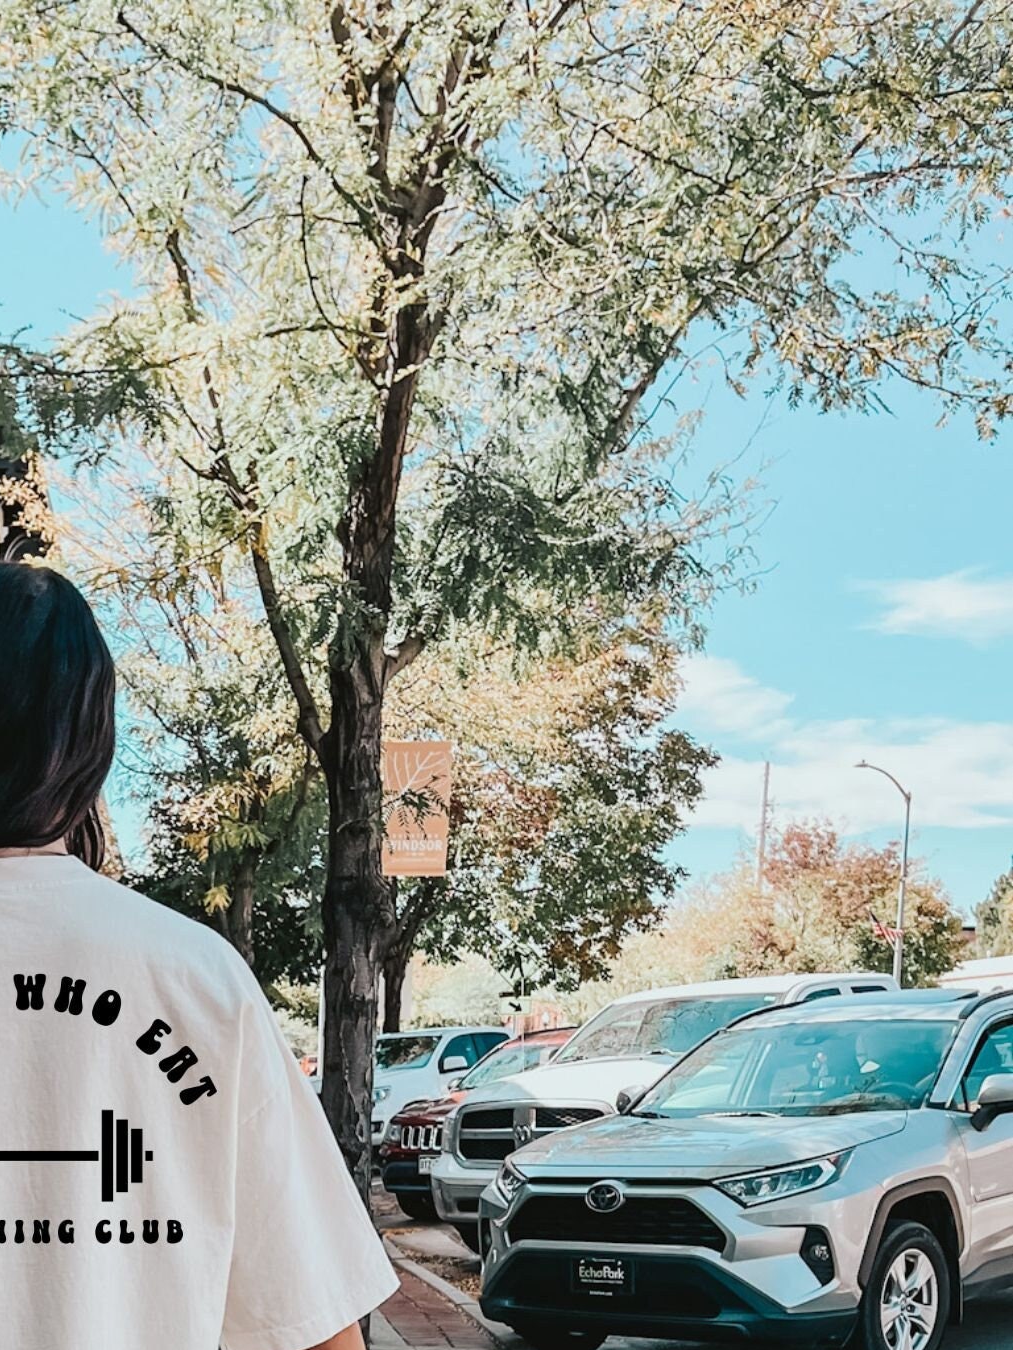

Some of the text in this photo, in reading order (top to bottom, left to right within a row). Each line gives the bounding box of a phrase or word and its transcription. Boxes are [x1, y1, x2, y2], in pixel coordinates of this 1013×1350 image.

[14, 974, 122, 1027] WHO
[136, 1019, 218, 1106] EAT
[94, 1219, 184, 1245] CLUB
[579, 1265, 625, 1279] EchoPark
